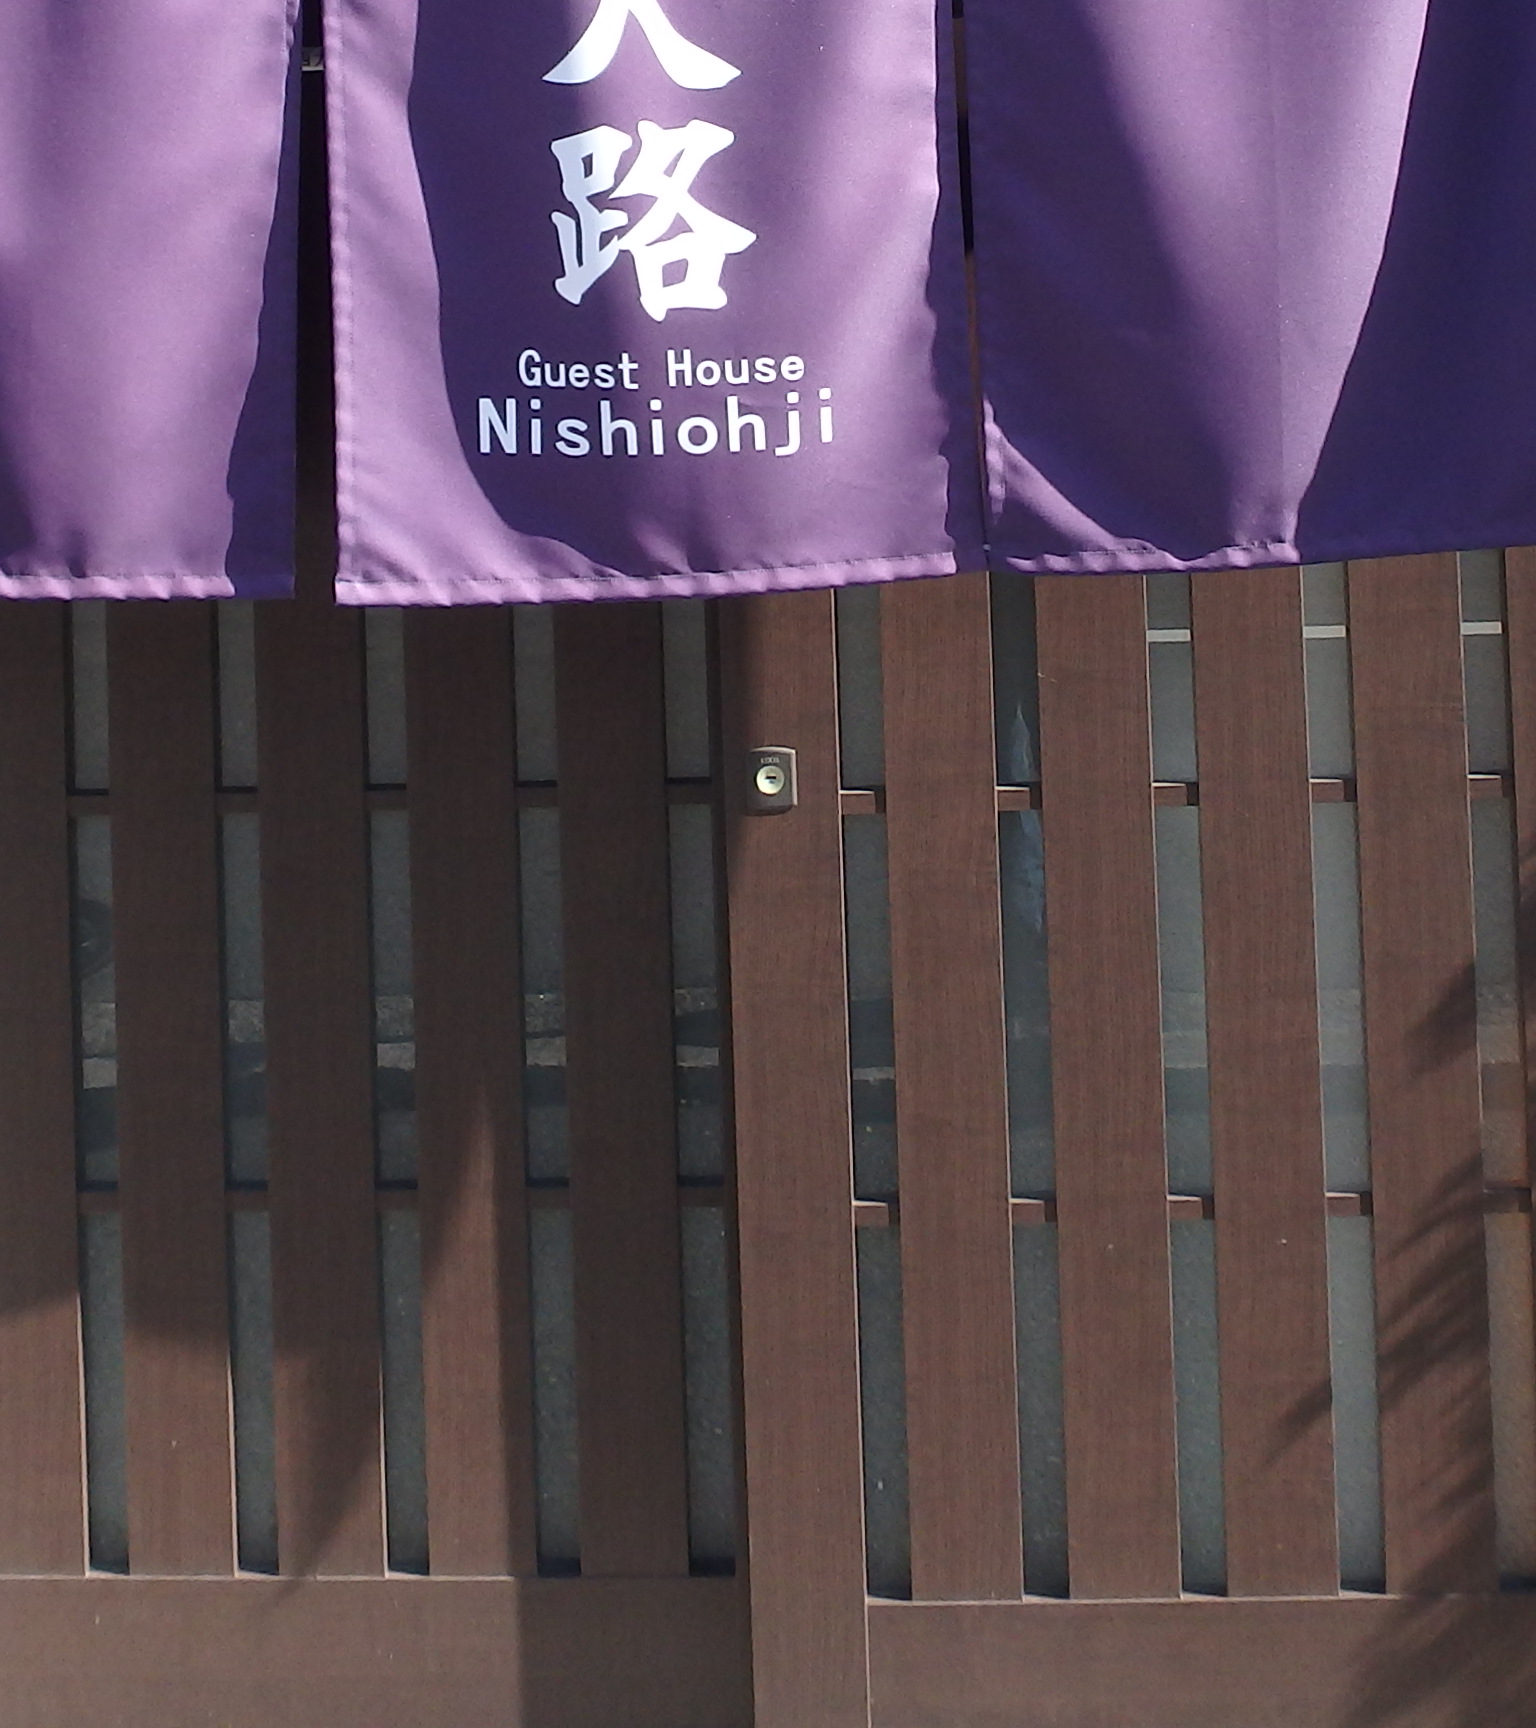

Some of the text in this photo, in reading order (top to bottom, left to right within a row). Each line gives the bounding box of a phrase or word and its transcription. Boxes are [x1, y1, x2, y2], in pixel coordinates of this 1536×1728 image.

[517, 348, 806, 390] Guest House
[478, 388, 836, 457] Nishiohji
